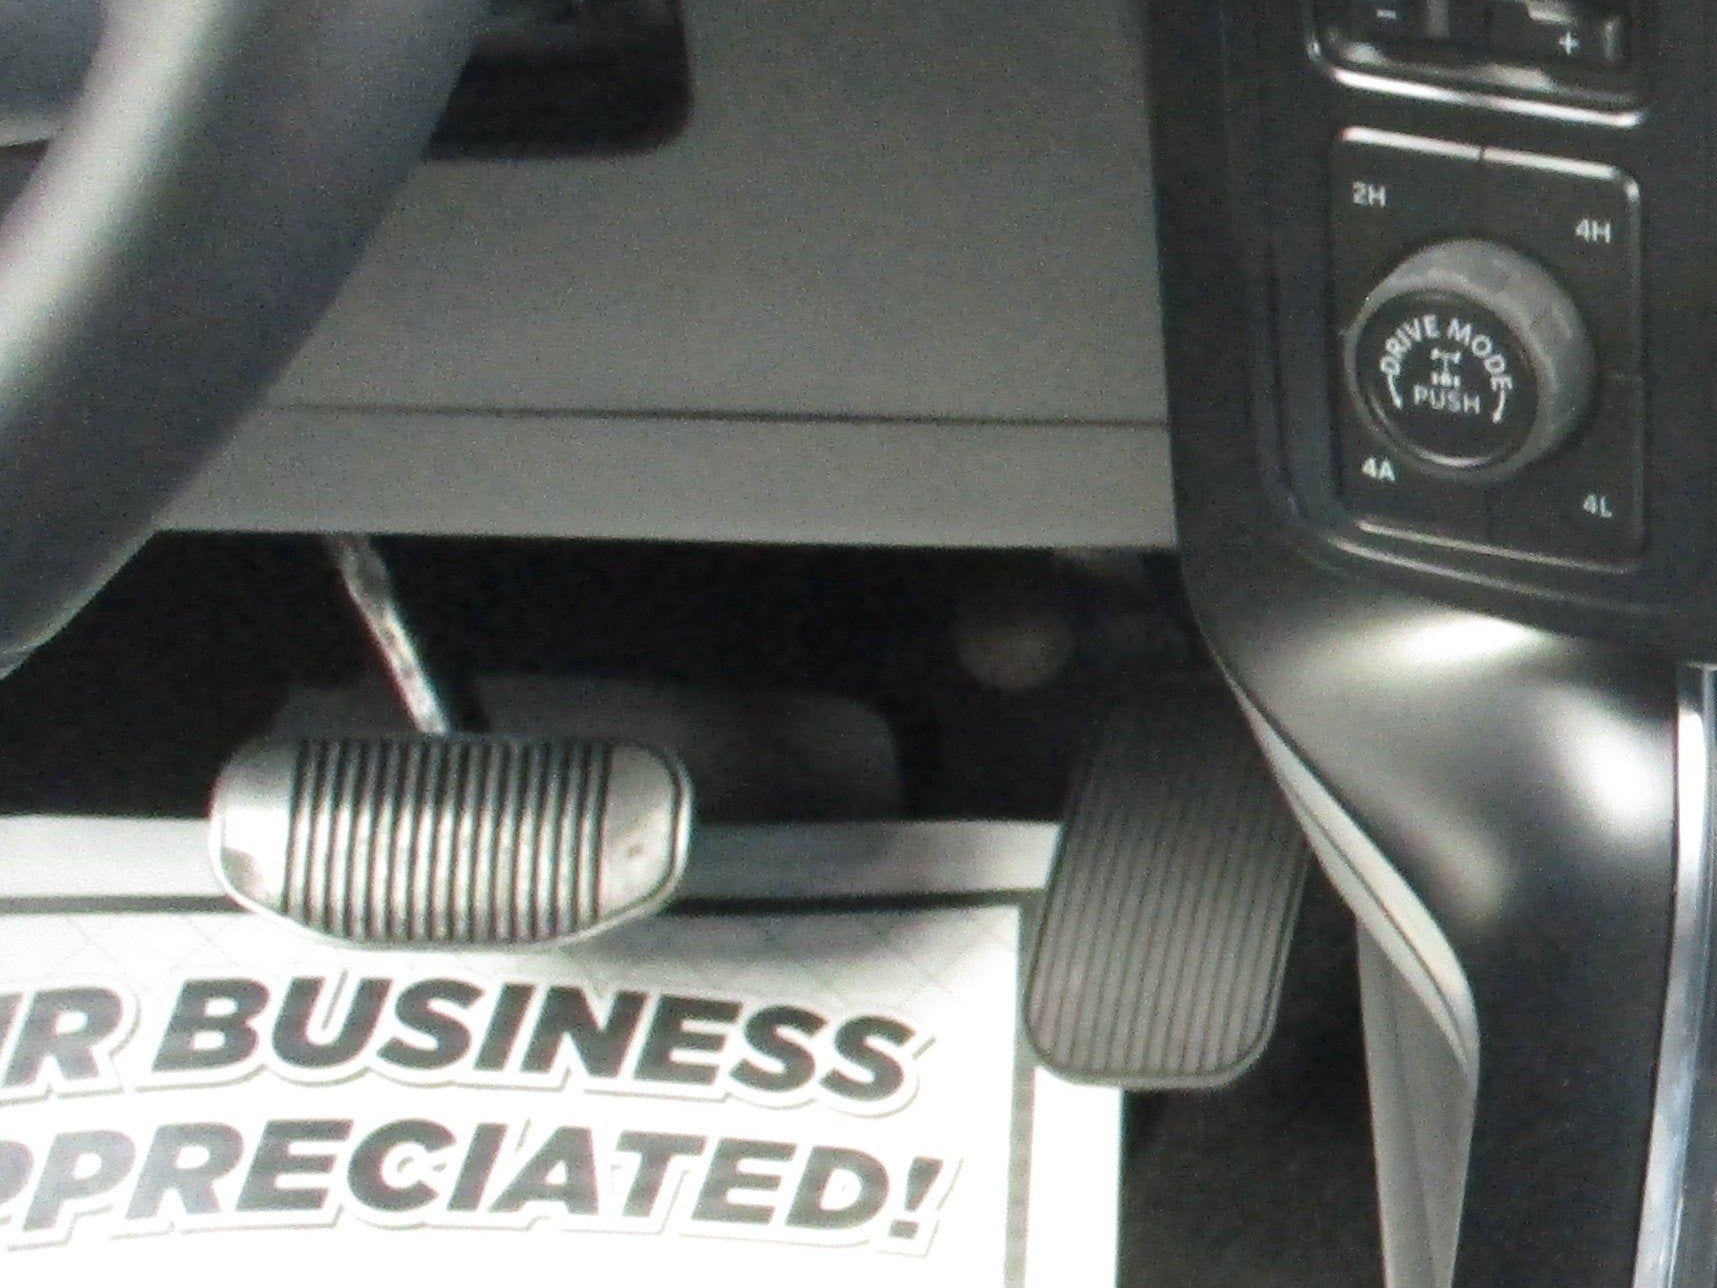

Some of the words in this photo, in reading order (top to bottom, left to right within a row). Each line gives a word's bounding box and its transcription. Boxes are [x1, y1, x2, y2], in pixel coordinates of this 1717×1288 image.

[1352, 179, 1387, 209] 2H
[1575, 218, 1613, 244] 4H
[1380, 314, 1441, 376] DRIVE
[1447, 317, 1514, 393] MODE
[1413, 383, 1481, 415] PUSH
[1361, 455, 1397, 482] 4A
[1582, 493, 1614, 518] 4L
[151, 975, 916, 1102] BUSINESS
